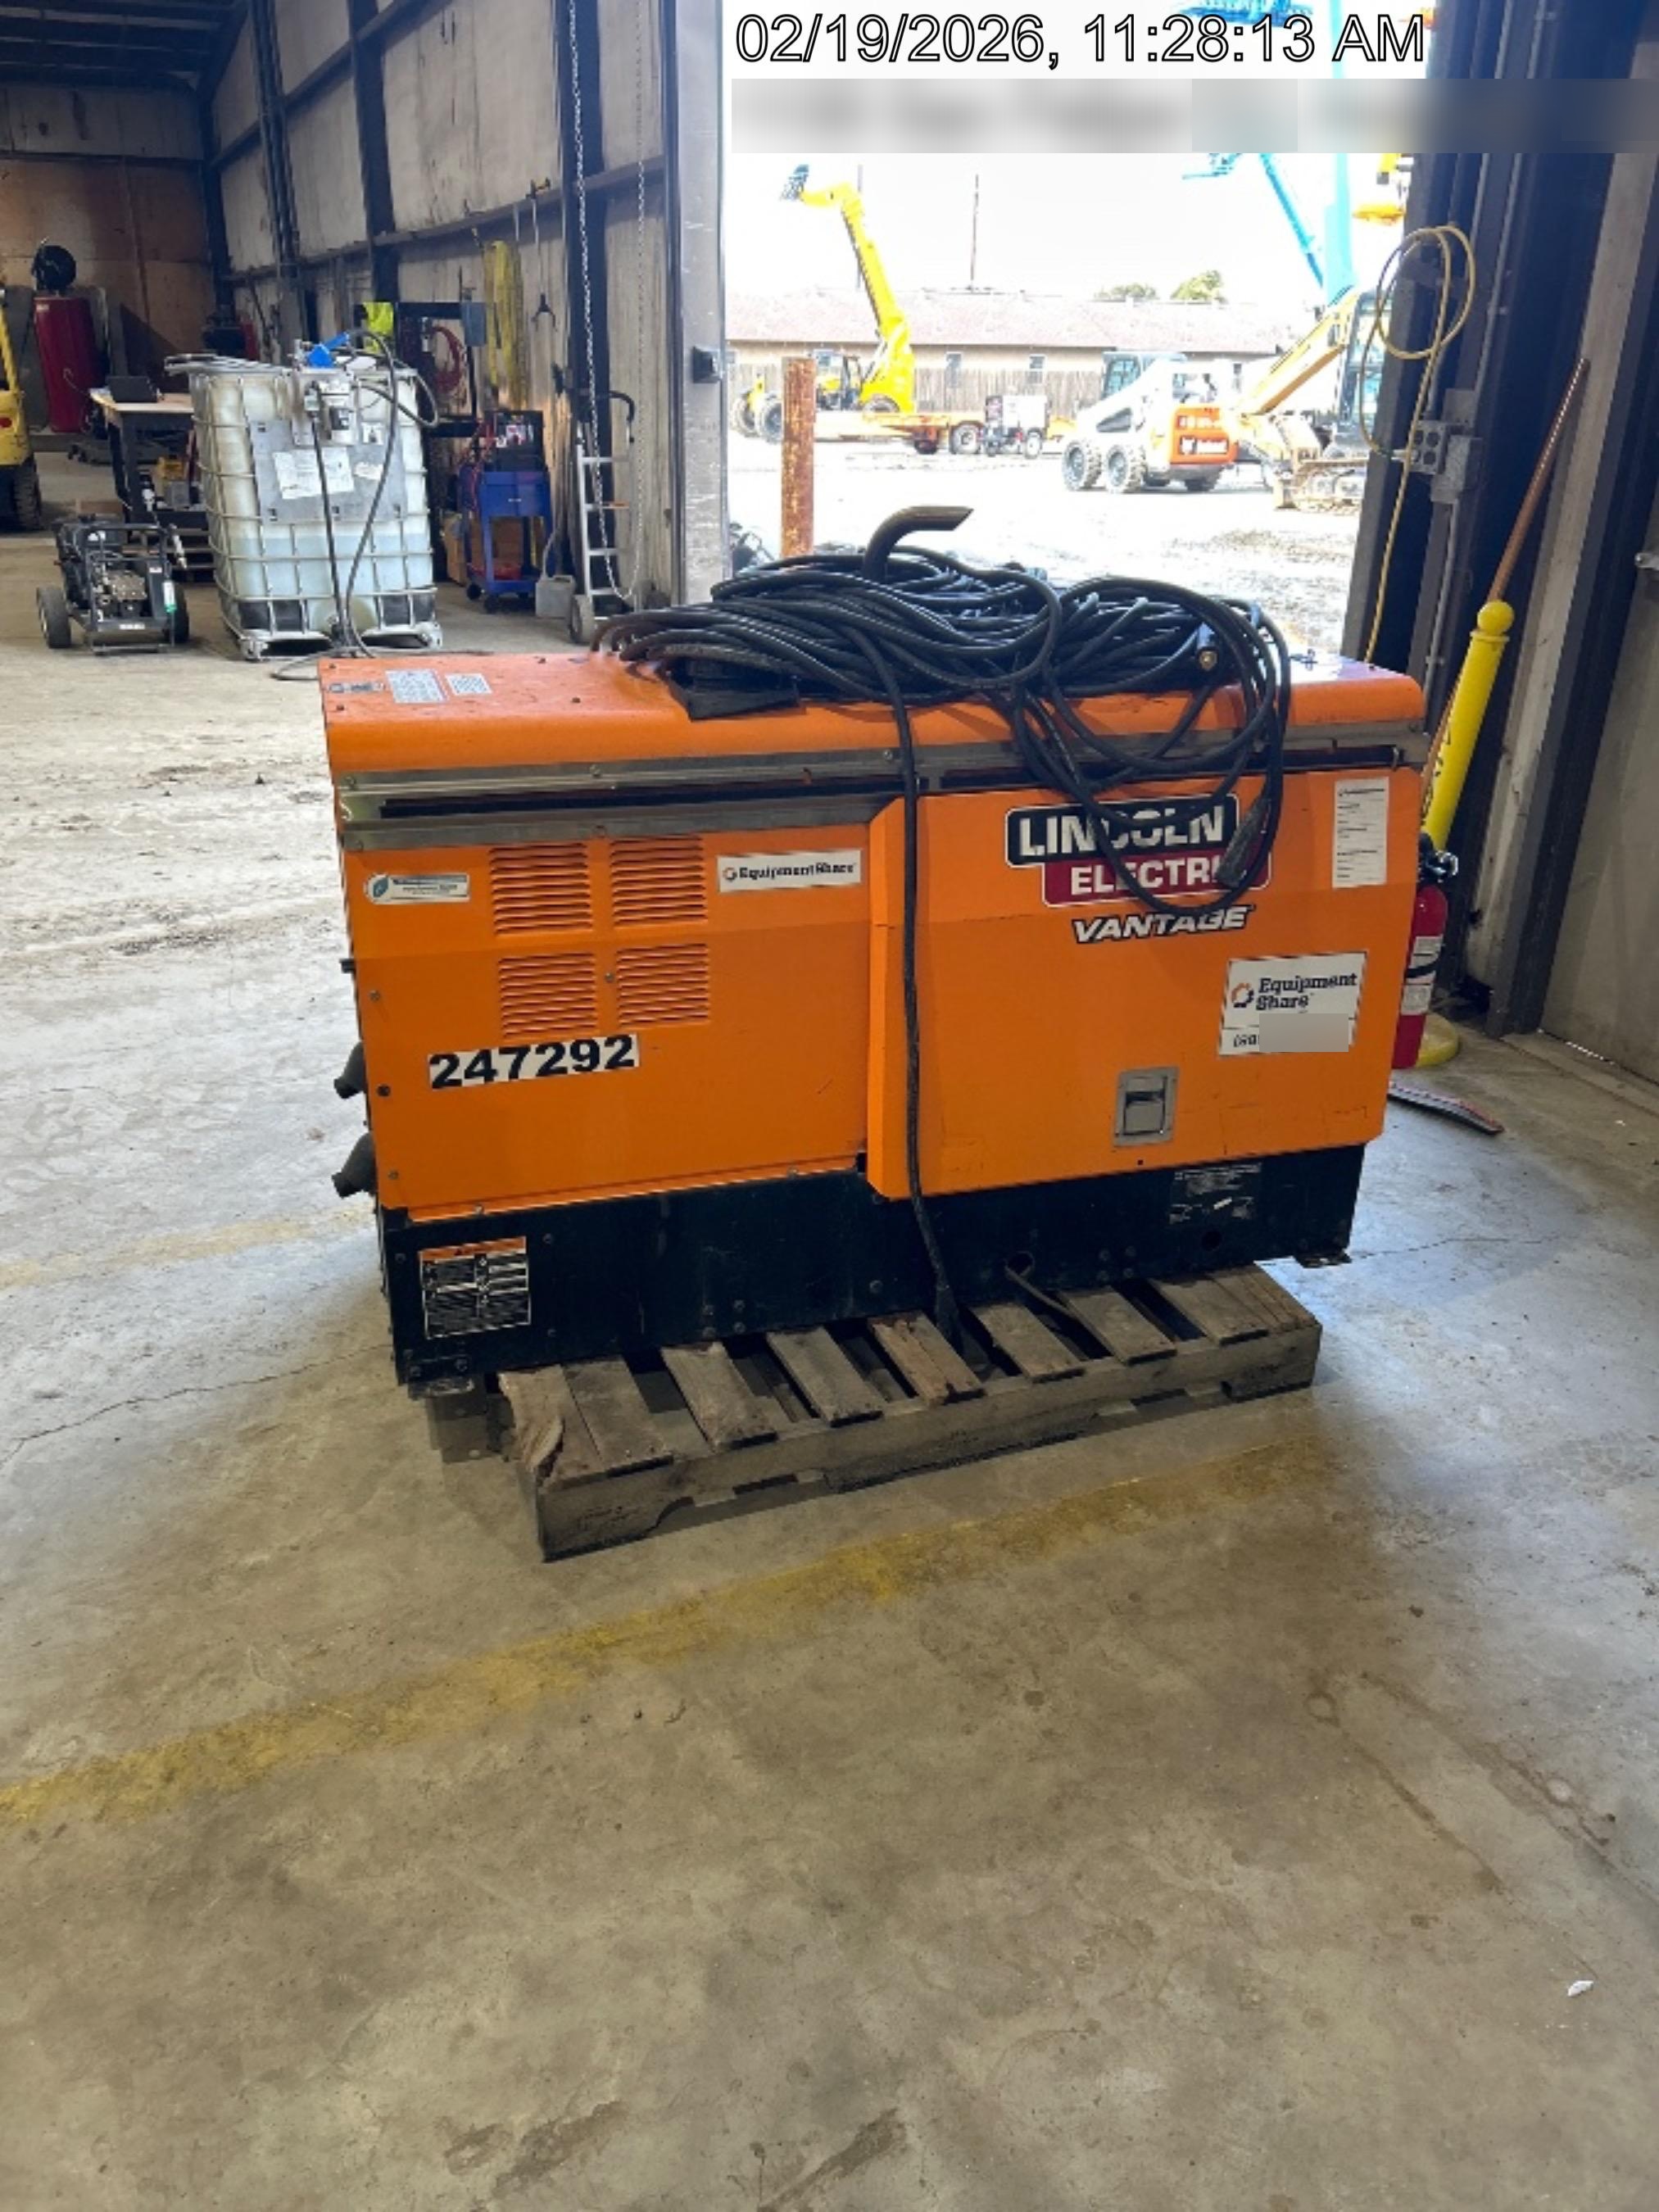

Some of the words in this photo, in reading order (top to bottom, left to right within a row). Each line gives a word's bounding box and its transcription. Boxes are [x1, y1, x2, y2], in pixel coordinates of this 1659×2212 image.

[1072, 905, 1253, 944] VANTAGE
[1258, 972, 1358, 995] Equipment
[1255, 994, 1310, 1012] Share
[428, 1033, 636, 1090] 247292
